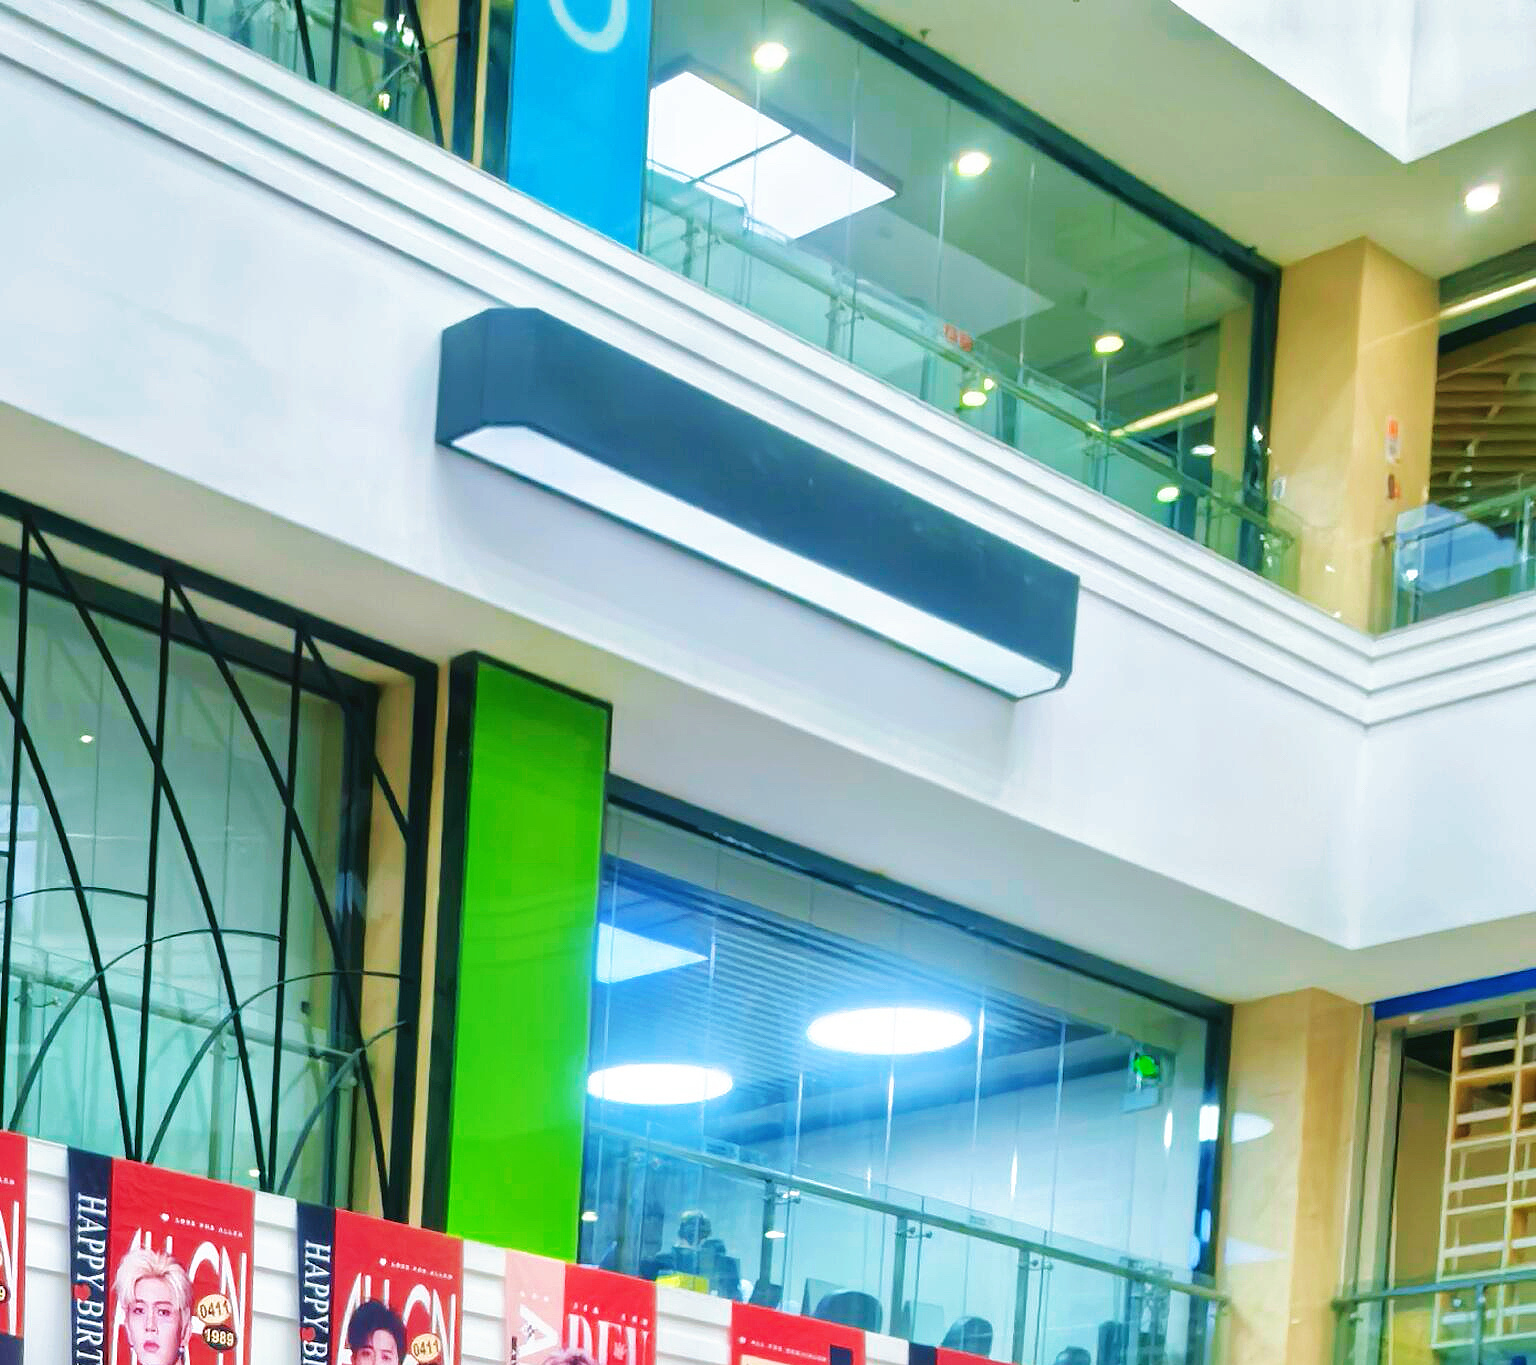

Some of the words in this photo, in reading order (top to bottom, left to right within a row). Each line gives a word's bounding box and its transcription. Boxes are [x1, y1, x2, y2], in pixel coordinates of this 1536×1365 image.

[76, 1192, 107, 1285] HAPPY
[199, 1298, 231, 1321] 0411
[203, 1328, 235, 1348] 1989
[412, 1339, 440, 1359] 0411
